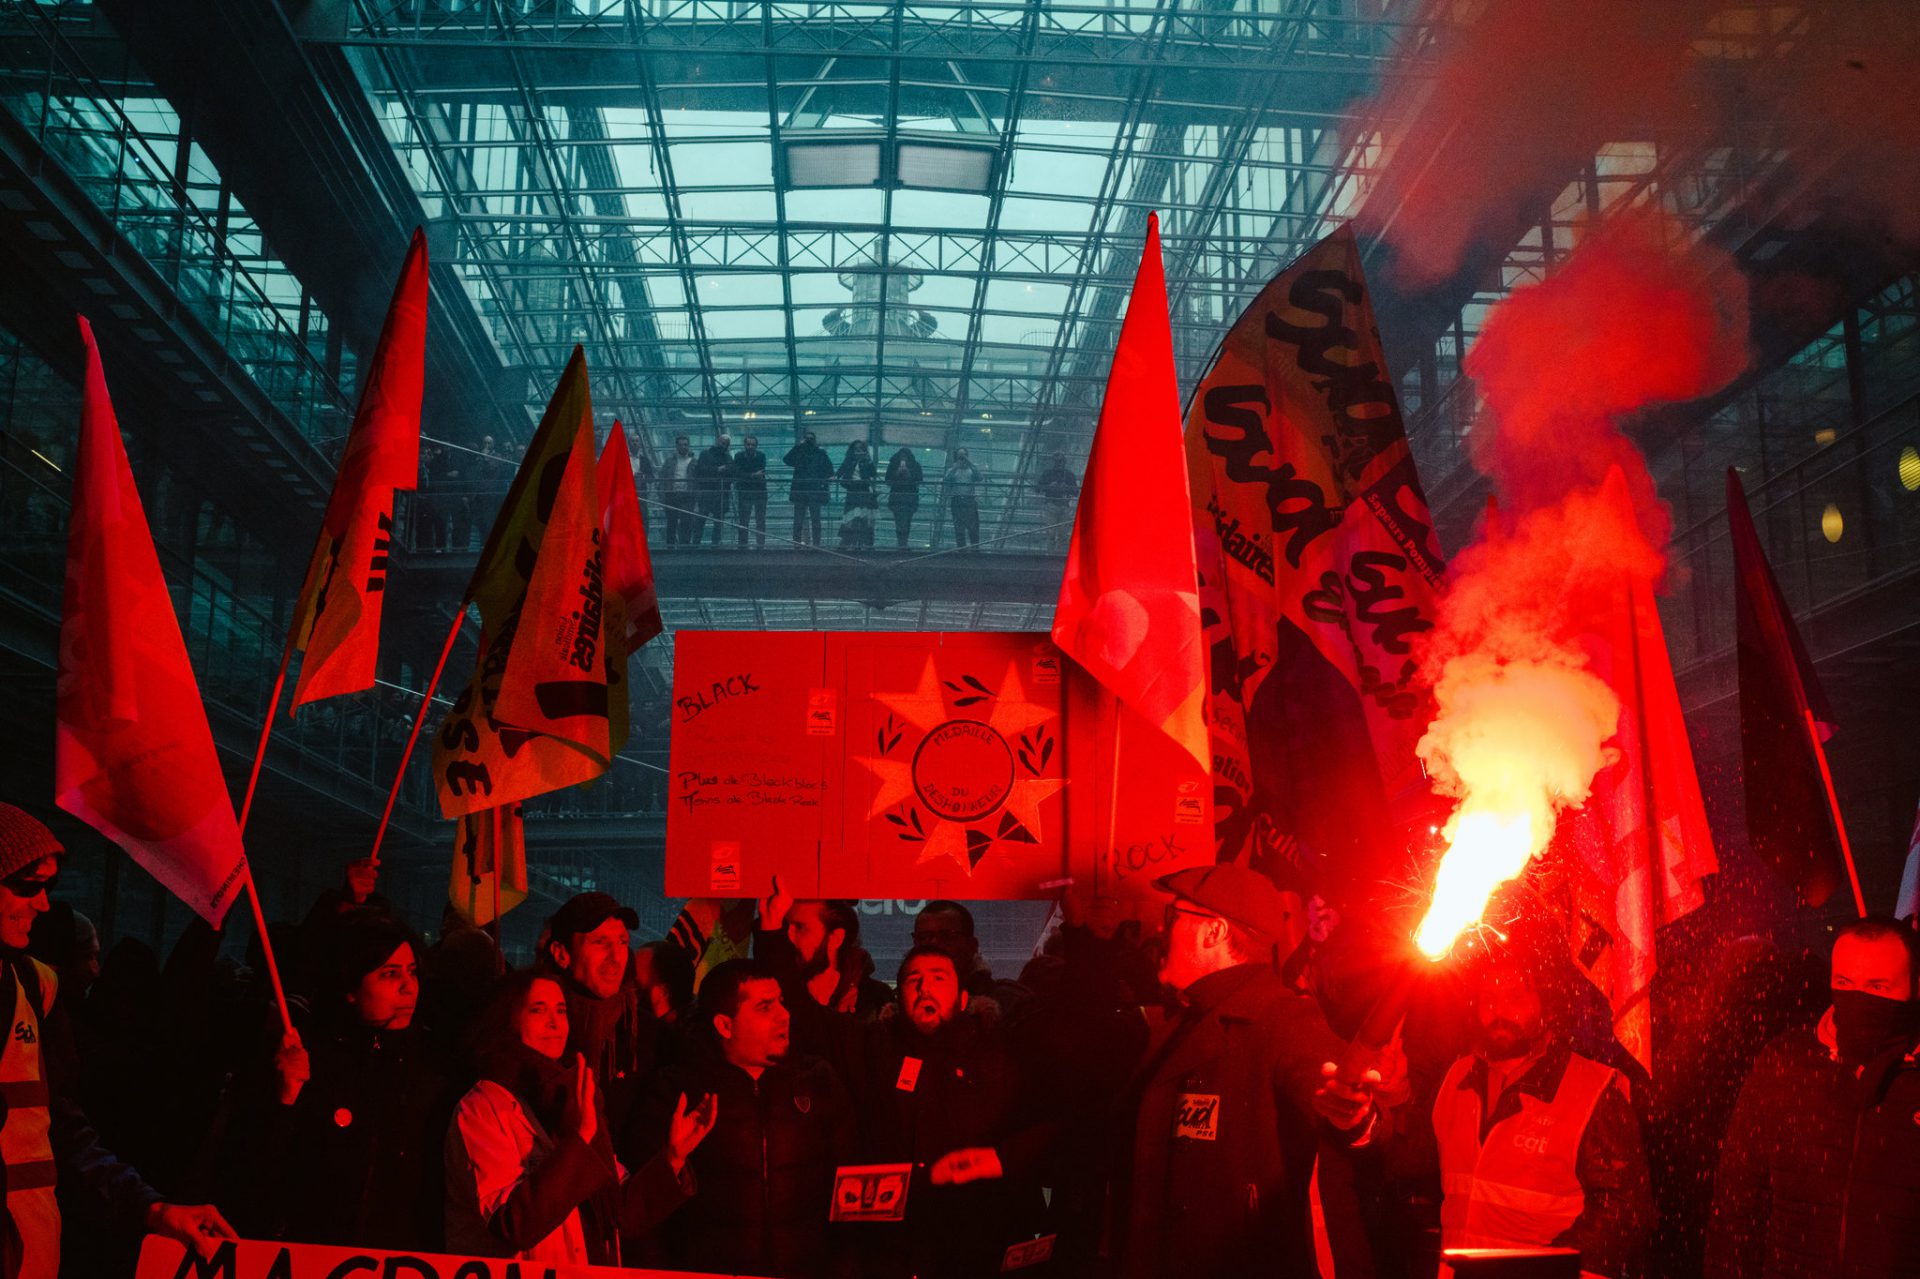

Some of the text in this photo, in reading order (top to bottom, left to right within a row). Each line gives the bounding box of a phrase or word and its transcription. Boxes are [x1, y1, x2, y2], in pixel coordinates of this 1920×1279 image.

[1368, 492, 1404, 546] Sapeurs
[676, 673, 760, 723] BLACK
[933, 724, 997, 747] MEDAILLE
[678, 771, 719, 790] Plus
[951, 786, 969, 798] DU
[1513, 1134, 1548, 1154] cgt
